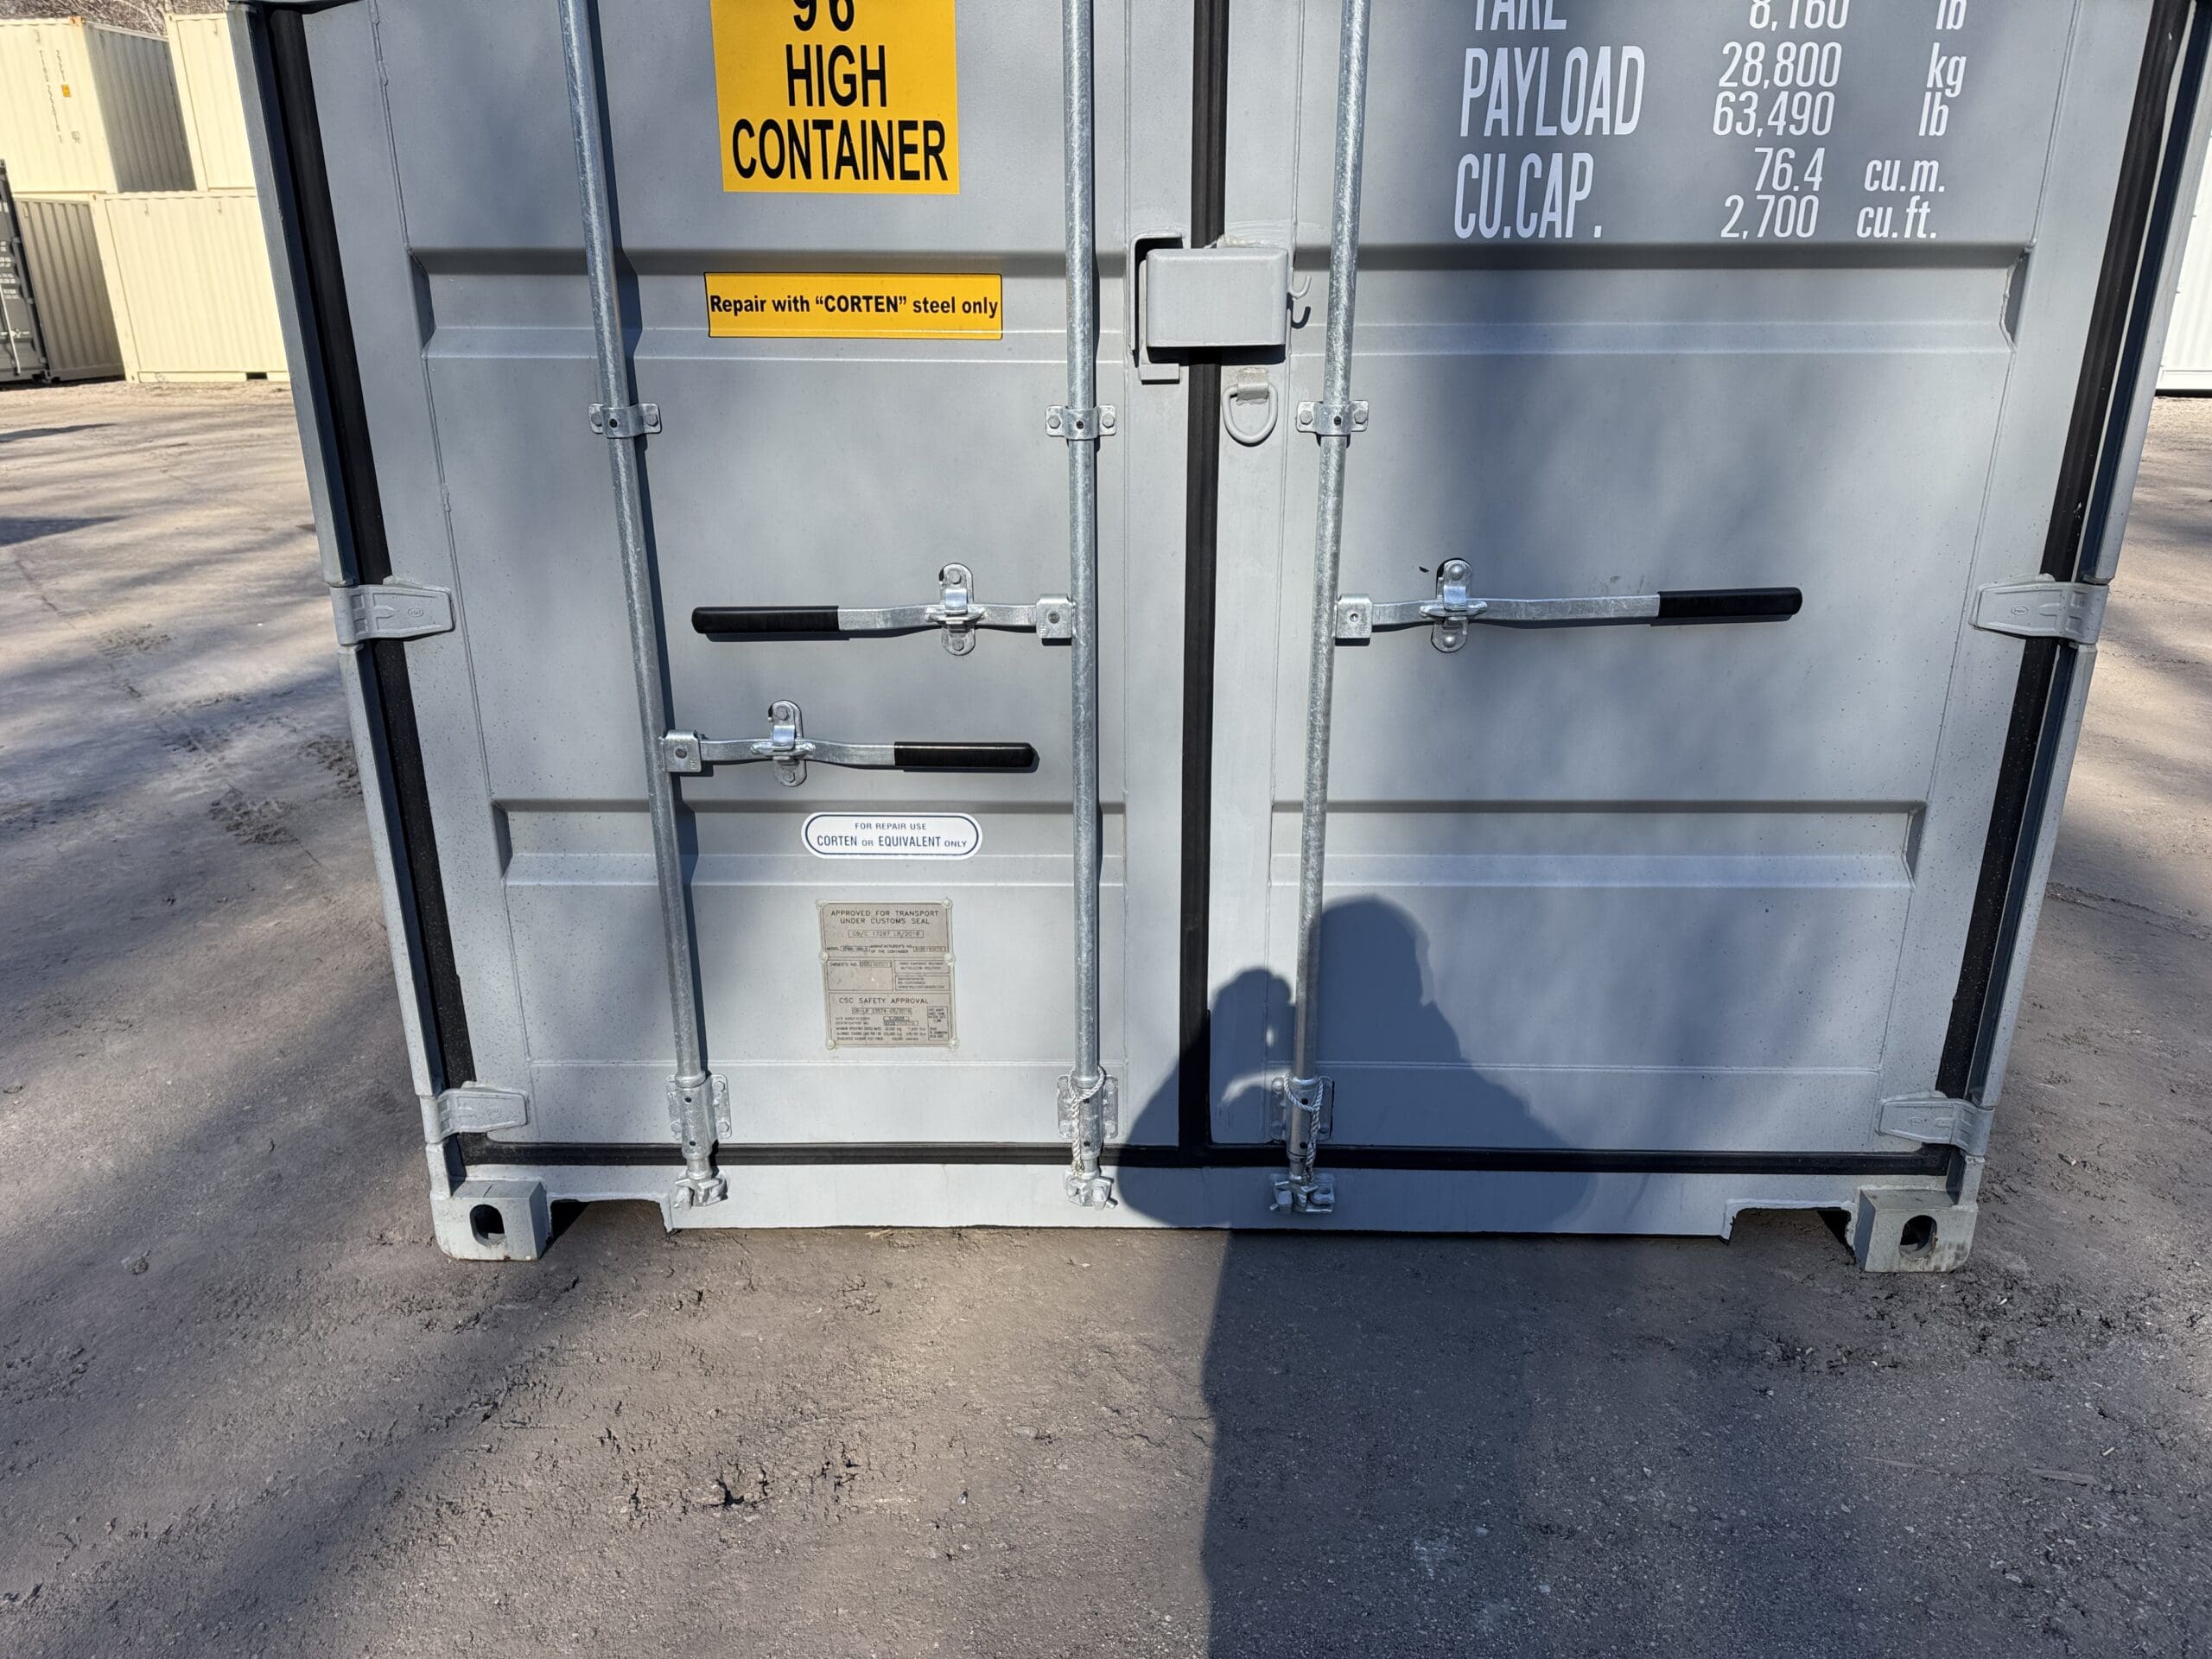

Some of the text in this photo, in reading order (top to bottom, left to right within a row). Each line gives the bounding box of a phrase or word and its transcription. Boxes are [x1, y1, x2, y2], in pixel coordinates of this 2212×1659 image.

[785, 44, 887, 107] HIGH
[1459, 41, 1967, 137] PAYLOAD 28,800 kg
[1712, 91, 1949, 138] 63,490 lb
[732, 118, 949, 181] CONTAINER
[1754, 148, 1826, 192] 76.4
[1864, 158, 1947, 193] cu.m.
[1720, 194, 1938, 240] 2,700 cu.ft.
[710, 295, 998, 318] Repair with “CORTEN” steel only
[817, 835, 857, 847] CORTEN
[879, 836, 941, 848] EQUIVALENT
